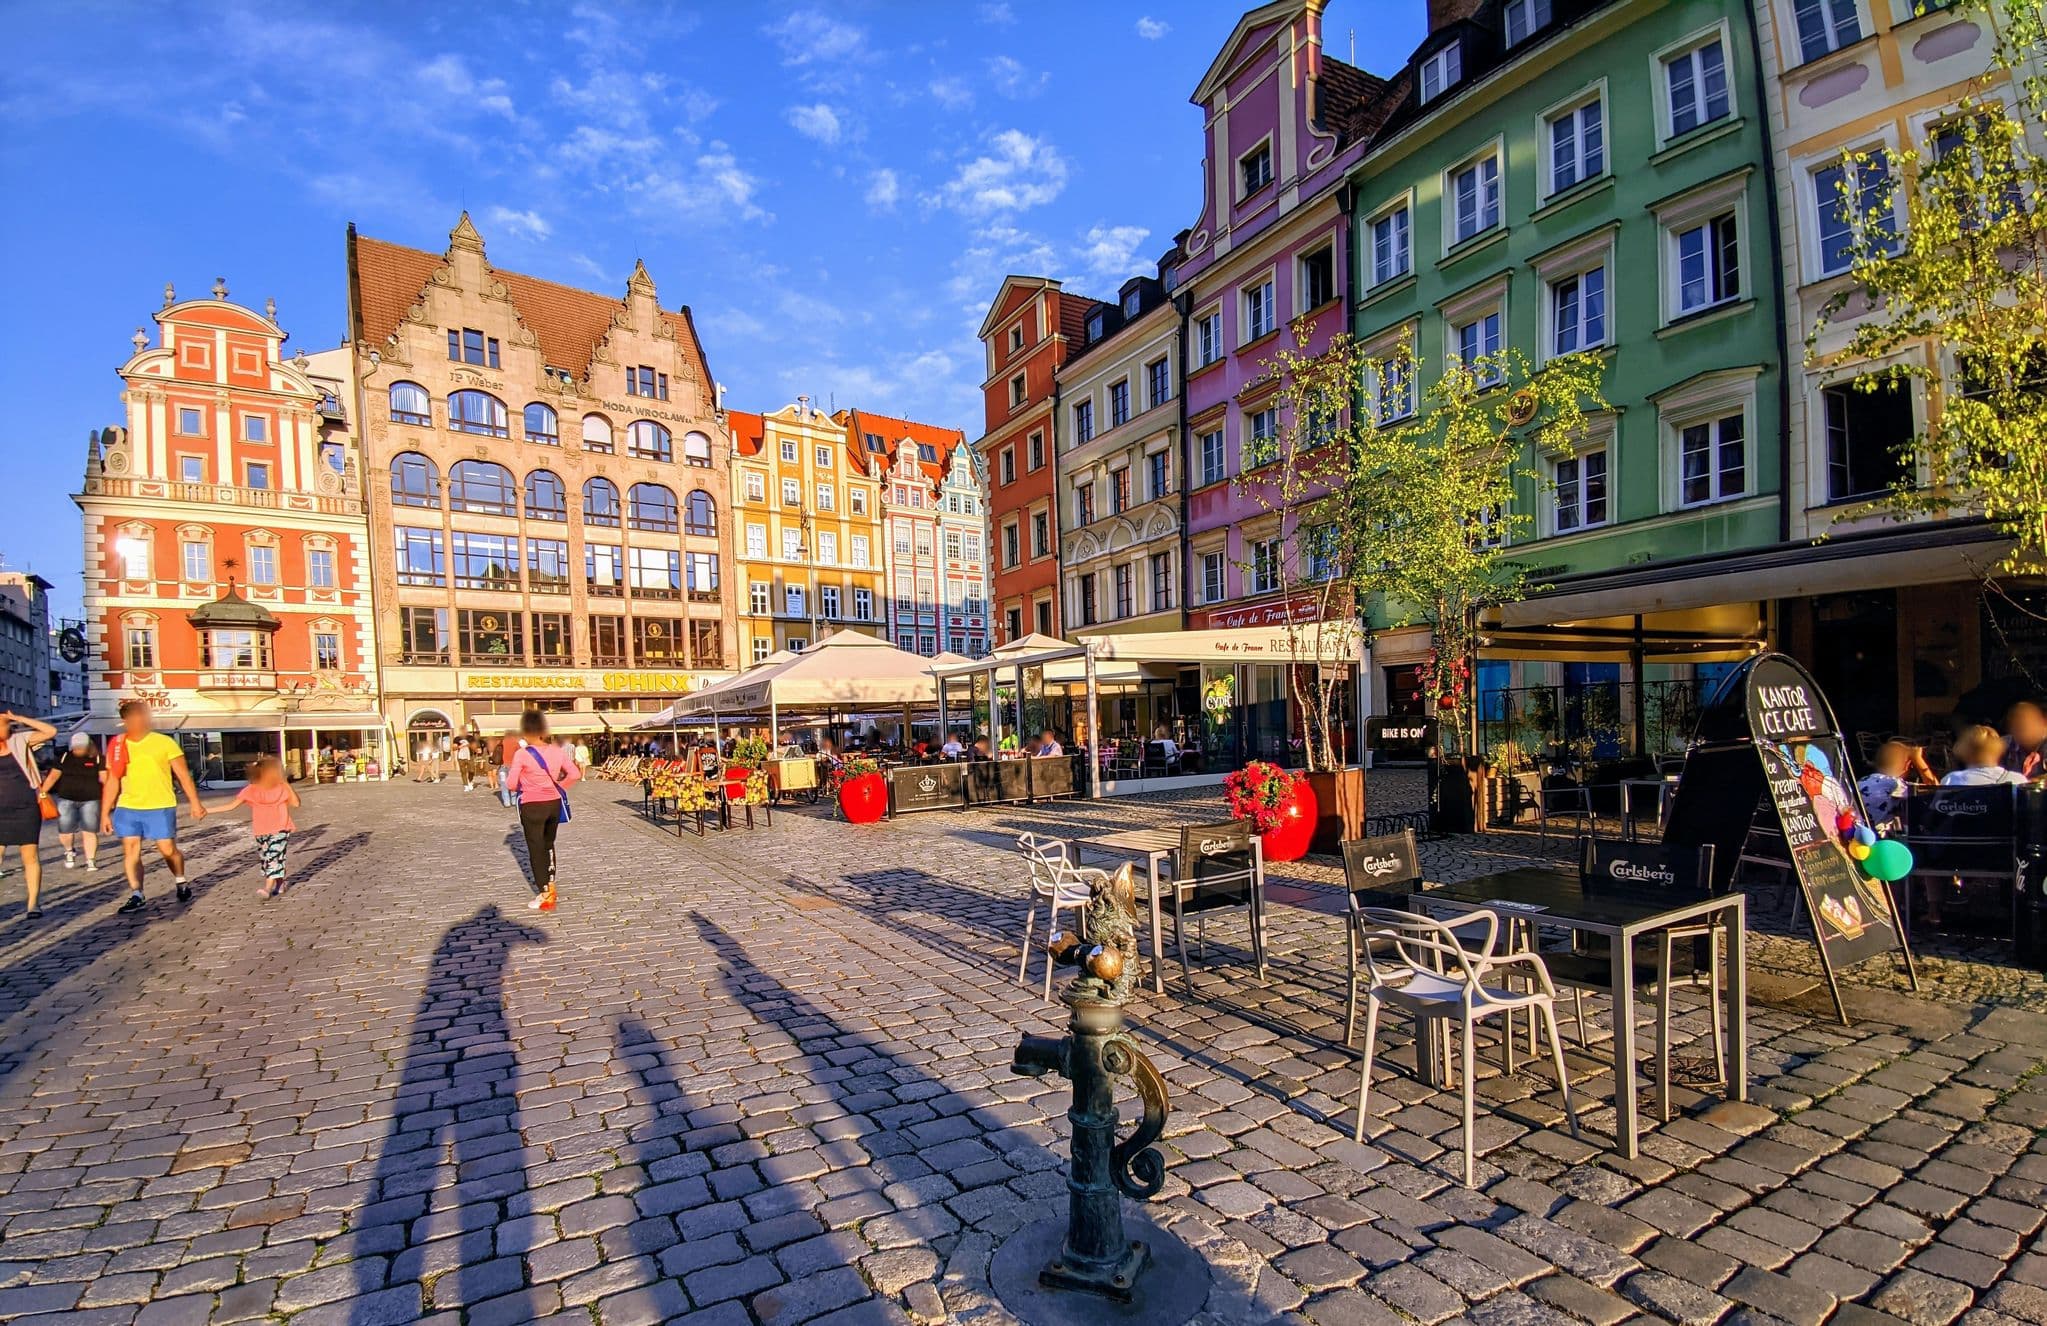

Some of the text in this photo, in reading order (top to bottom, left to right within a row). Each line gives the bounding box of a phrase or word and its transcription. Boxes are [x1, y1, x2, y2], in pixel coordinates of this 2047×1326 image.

[466, 375, 504, 391] Weber
[602, 401, 633, 414] MODA
[635, 406, 685, 424] WROCŁAW
[1226, 614, 1246, 628] Cafe
[1249, 612, 1259, 624] de
[1264, 608, 1296, 624] Frane
[1215, 642, 1229, 652] Cafe
[1231, 642, 1239, 651] de
[468, 675, 584, 689] RESTAURACJA
[602, 672, 690, 692] SPHINX
[1759, 708, 1816, 735] ICE CAFE
[1382, 728, 1424, 739] BIKE IS ON
[1935, 800, 1987, 816] Carlsberg
[1610, 860, 1674, 884] Carlsberg
